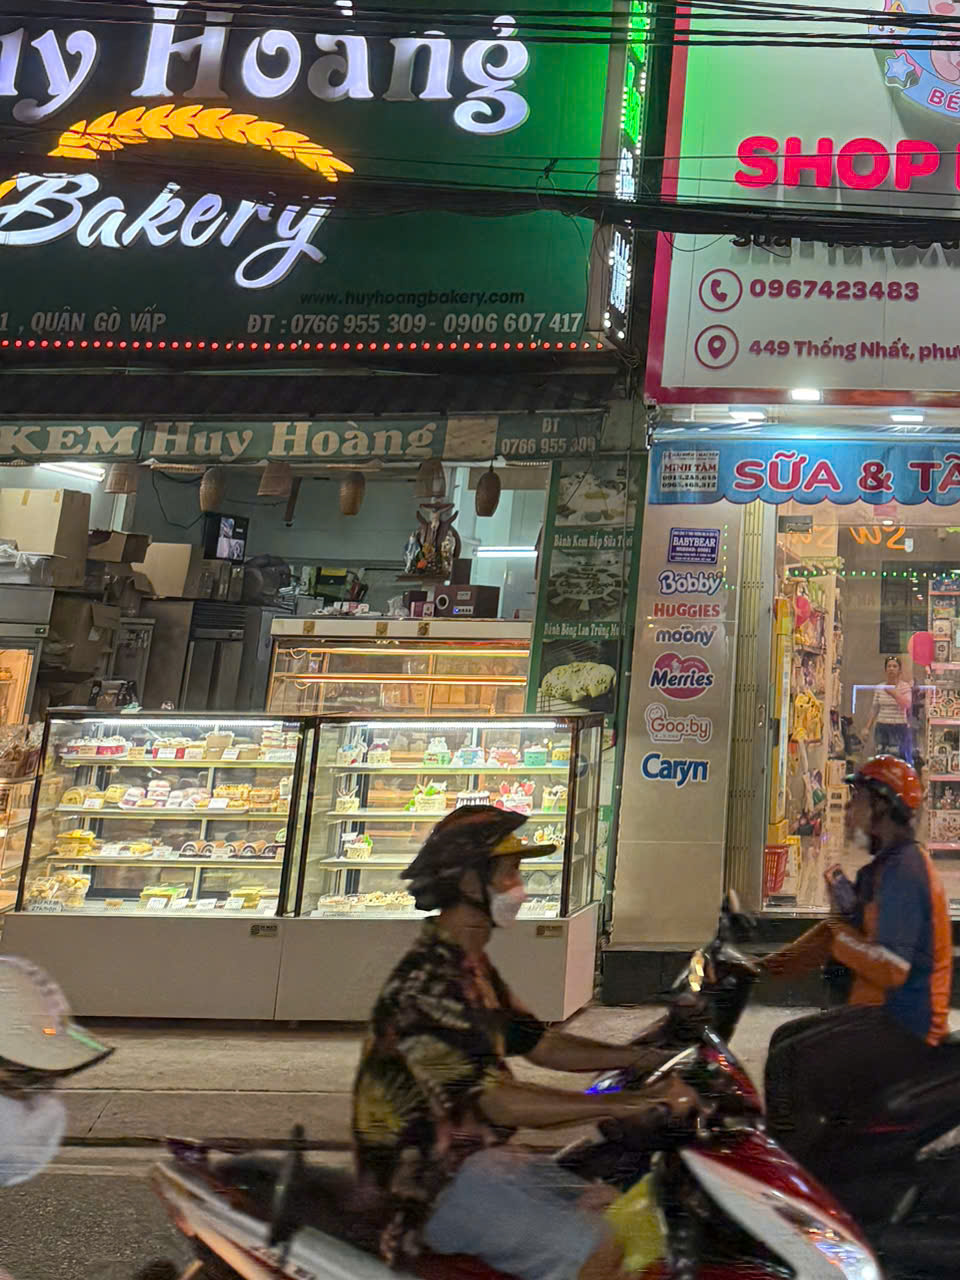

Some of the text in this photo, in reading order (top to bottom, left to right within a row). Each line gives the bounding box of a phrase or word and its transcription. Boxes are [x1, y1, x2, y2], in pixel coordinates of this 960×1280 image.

[131, 0, 529, 135] Hoàng
[734, 135, 941, 191] SHOP
[0, 173, 337, 289] Bakery
[300, 288, 526, 308] www.huyhoangbakery.com
[750, 278, 920, 301] 0967423483
[31, 305, 86, 335] QUẬN
[94, 306, 121, 332] GÒ
[130, 303, 167, 333] VẤP
[290, 313, 340, 334] 0766
[343, 314, 381, 334] 955
[443, 313, 499, 334] 0906
[503, 313, 546, 333] 607
[549, 312, 583, 333] 417
[749, 339, 790, 357] 449
[794, 336, 857, 361] Thống
[860, 337, 915, 361] Nhất,
[0, 419, 437, 462] KEM Huy Hoàng
[501, 438, 537, 455] 0766
[540, 437, 567, 454] 955
[733, 451, 842, 494] SỮA
[857, 460, 894, 492] &
[672, 536, 716, 548] BABYBEAR
[658, 570, 723, 596] Bobby
[653, 602, 721, 618] HUGGIES
[656, 627, 716, 647] moony
[650, 669, 714, 688] Merries
[642, 752, 709, 787] Caryn
